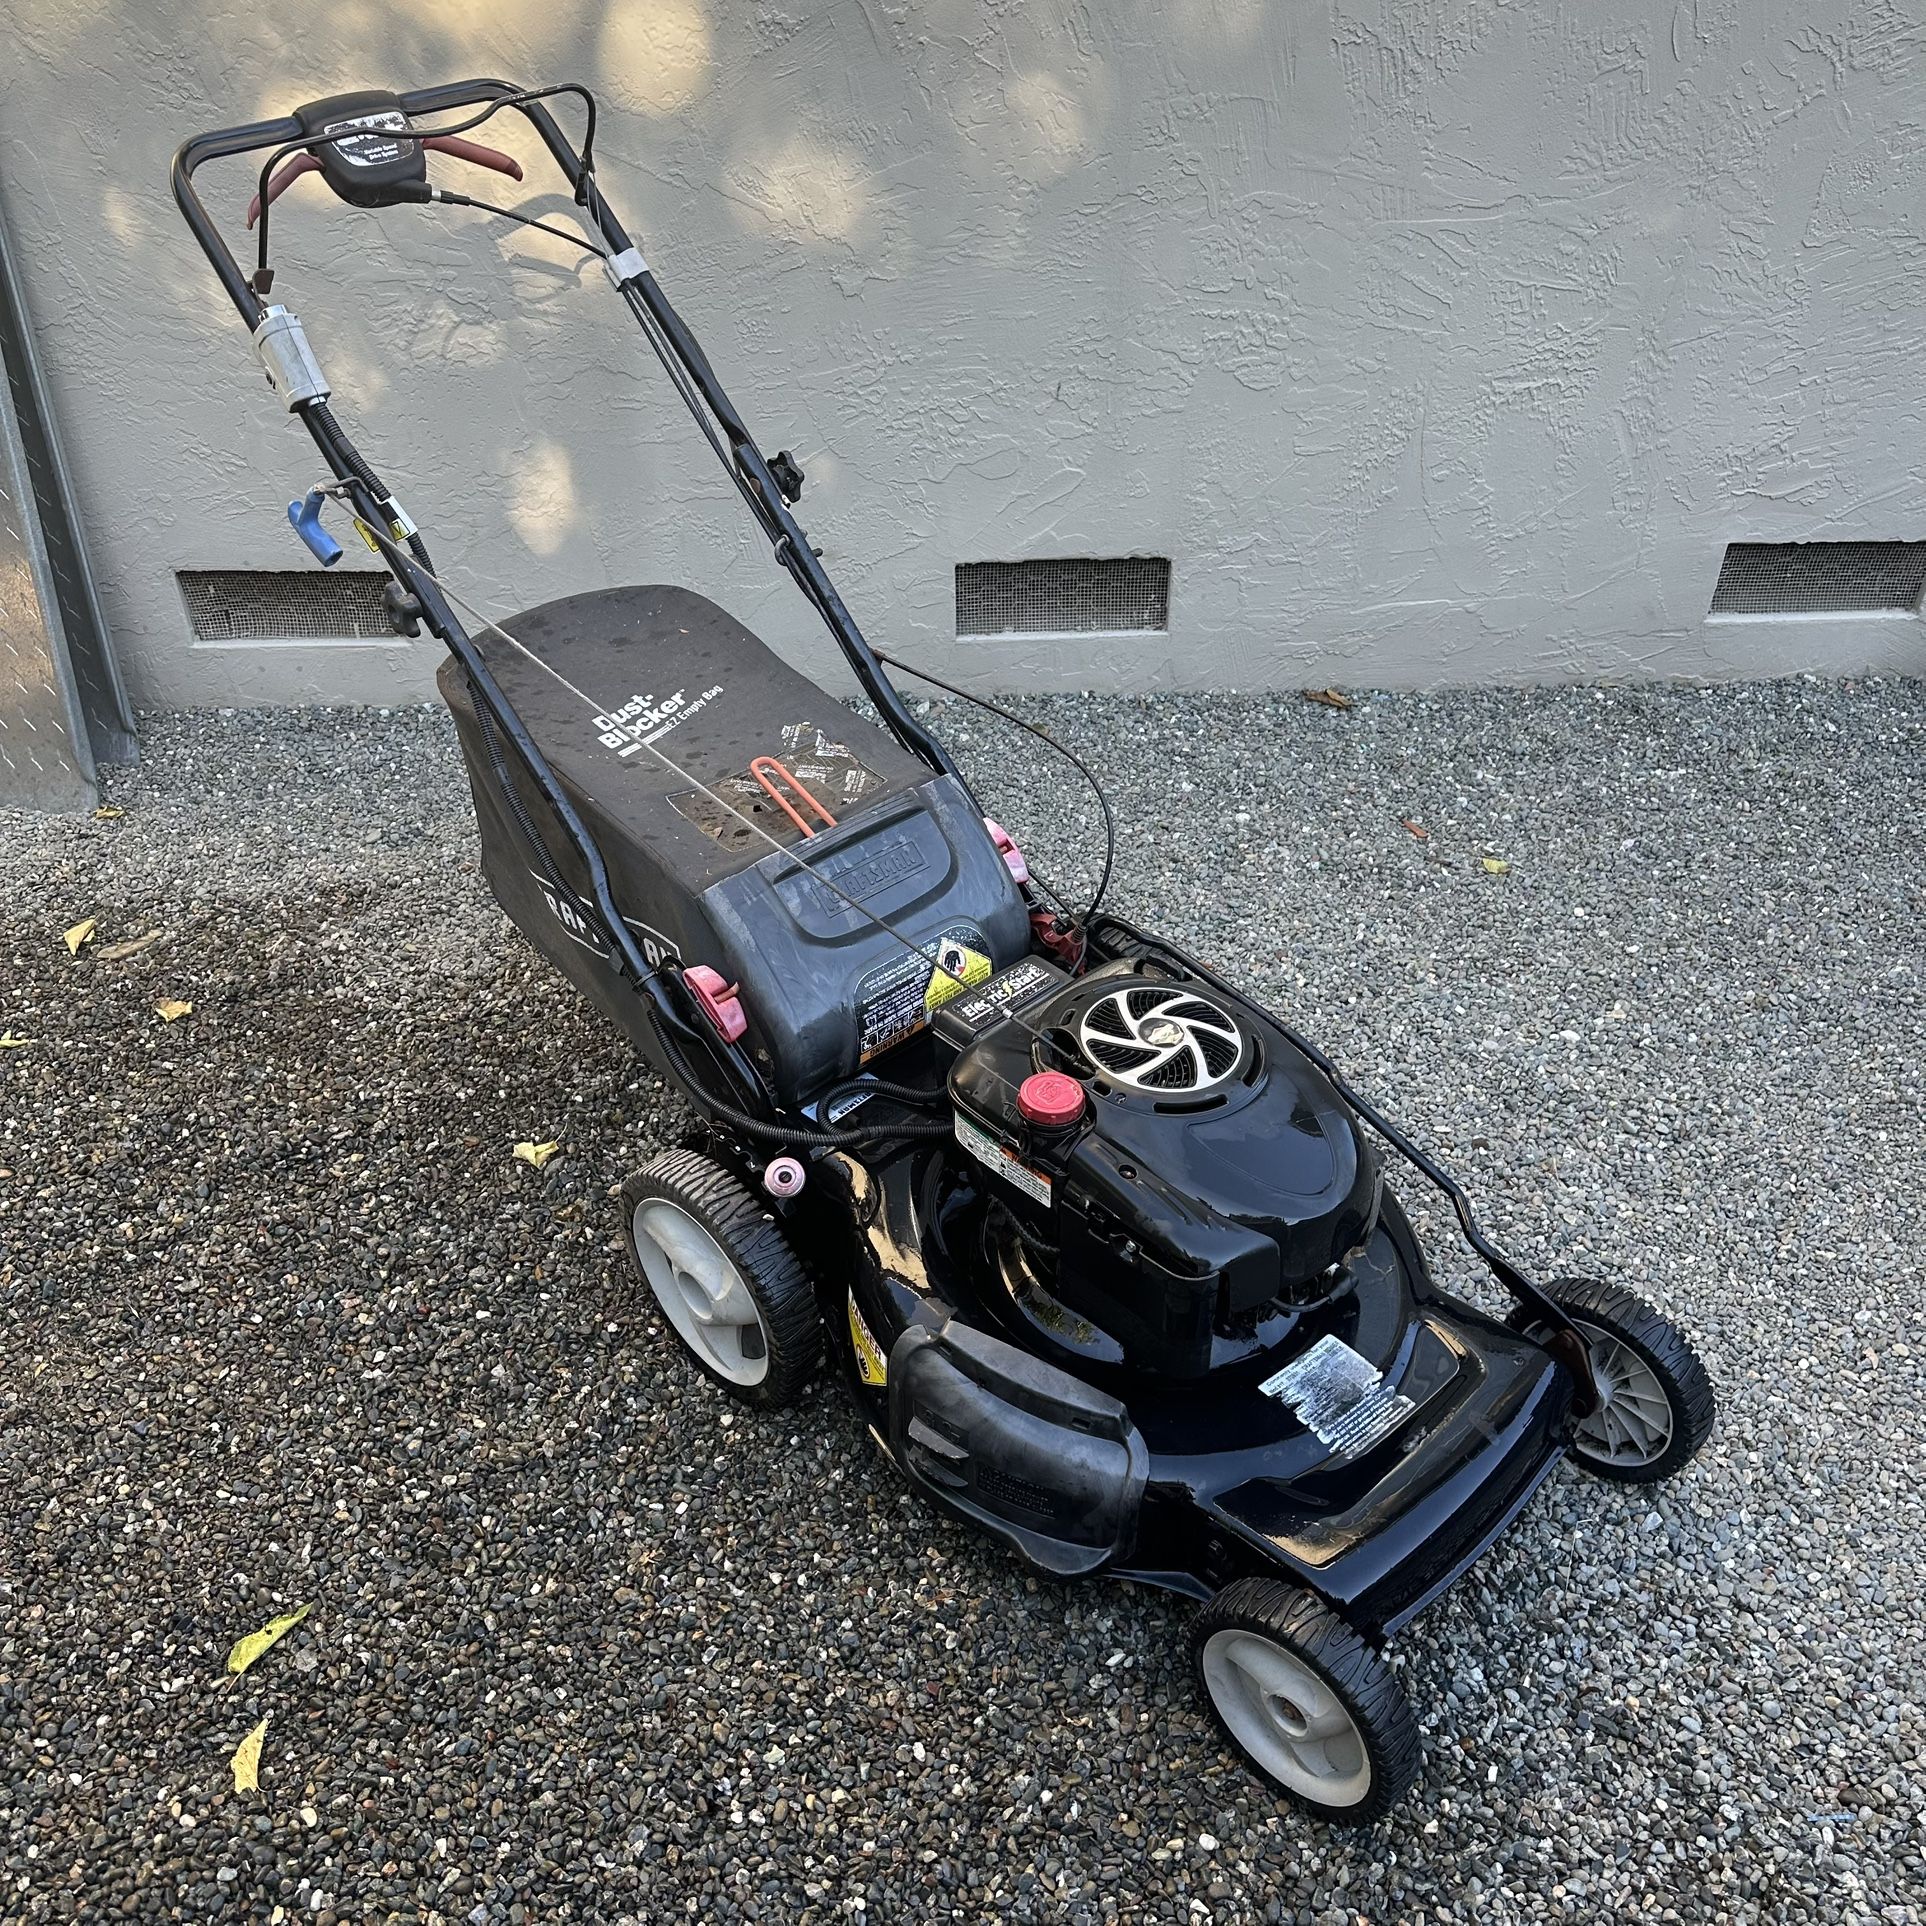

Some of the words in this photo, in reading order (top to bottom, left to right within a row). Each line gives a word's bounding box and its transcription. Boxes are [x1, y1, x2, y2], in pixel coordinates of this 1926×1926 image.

[591, 694, 654, 732] Dust-
[666, 716, 682, 729] EZ
[676, 698, 708, 721] Empty
[701, 684, 724, 701] Bag
[826, 848, 917, 905] CAFTSMAN
[962, 987, 1009, 1018] Elecric
[1008, 966, 1042, 991] Start
